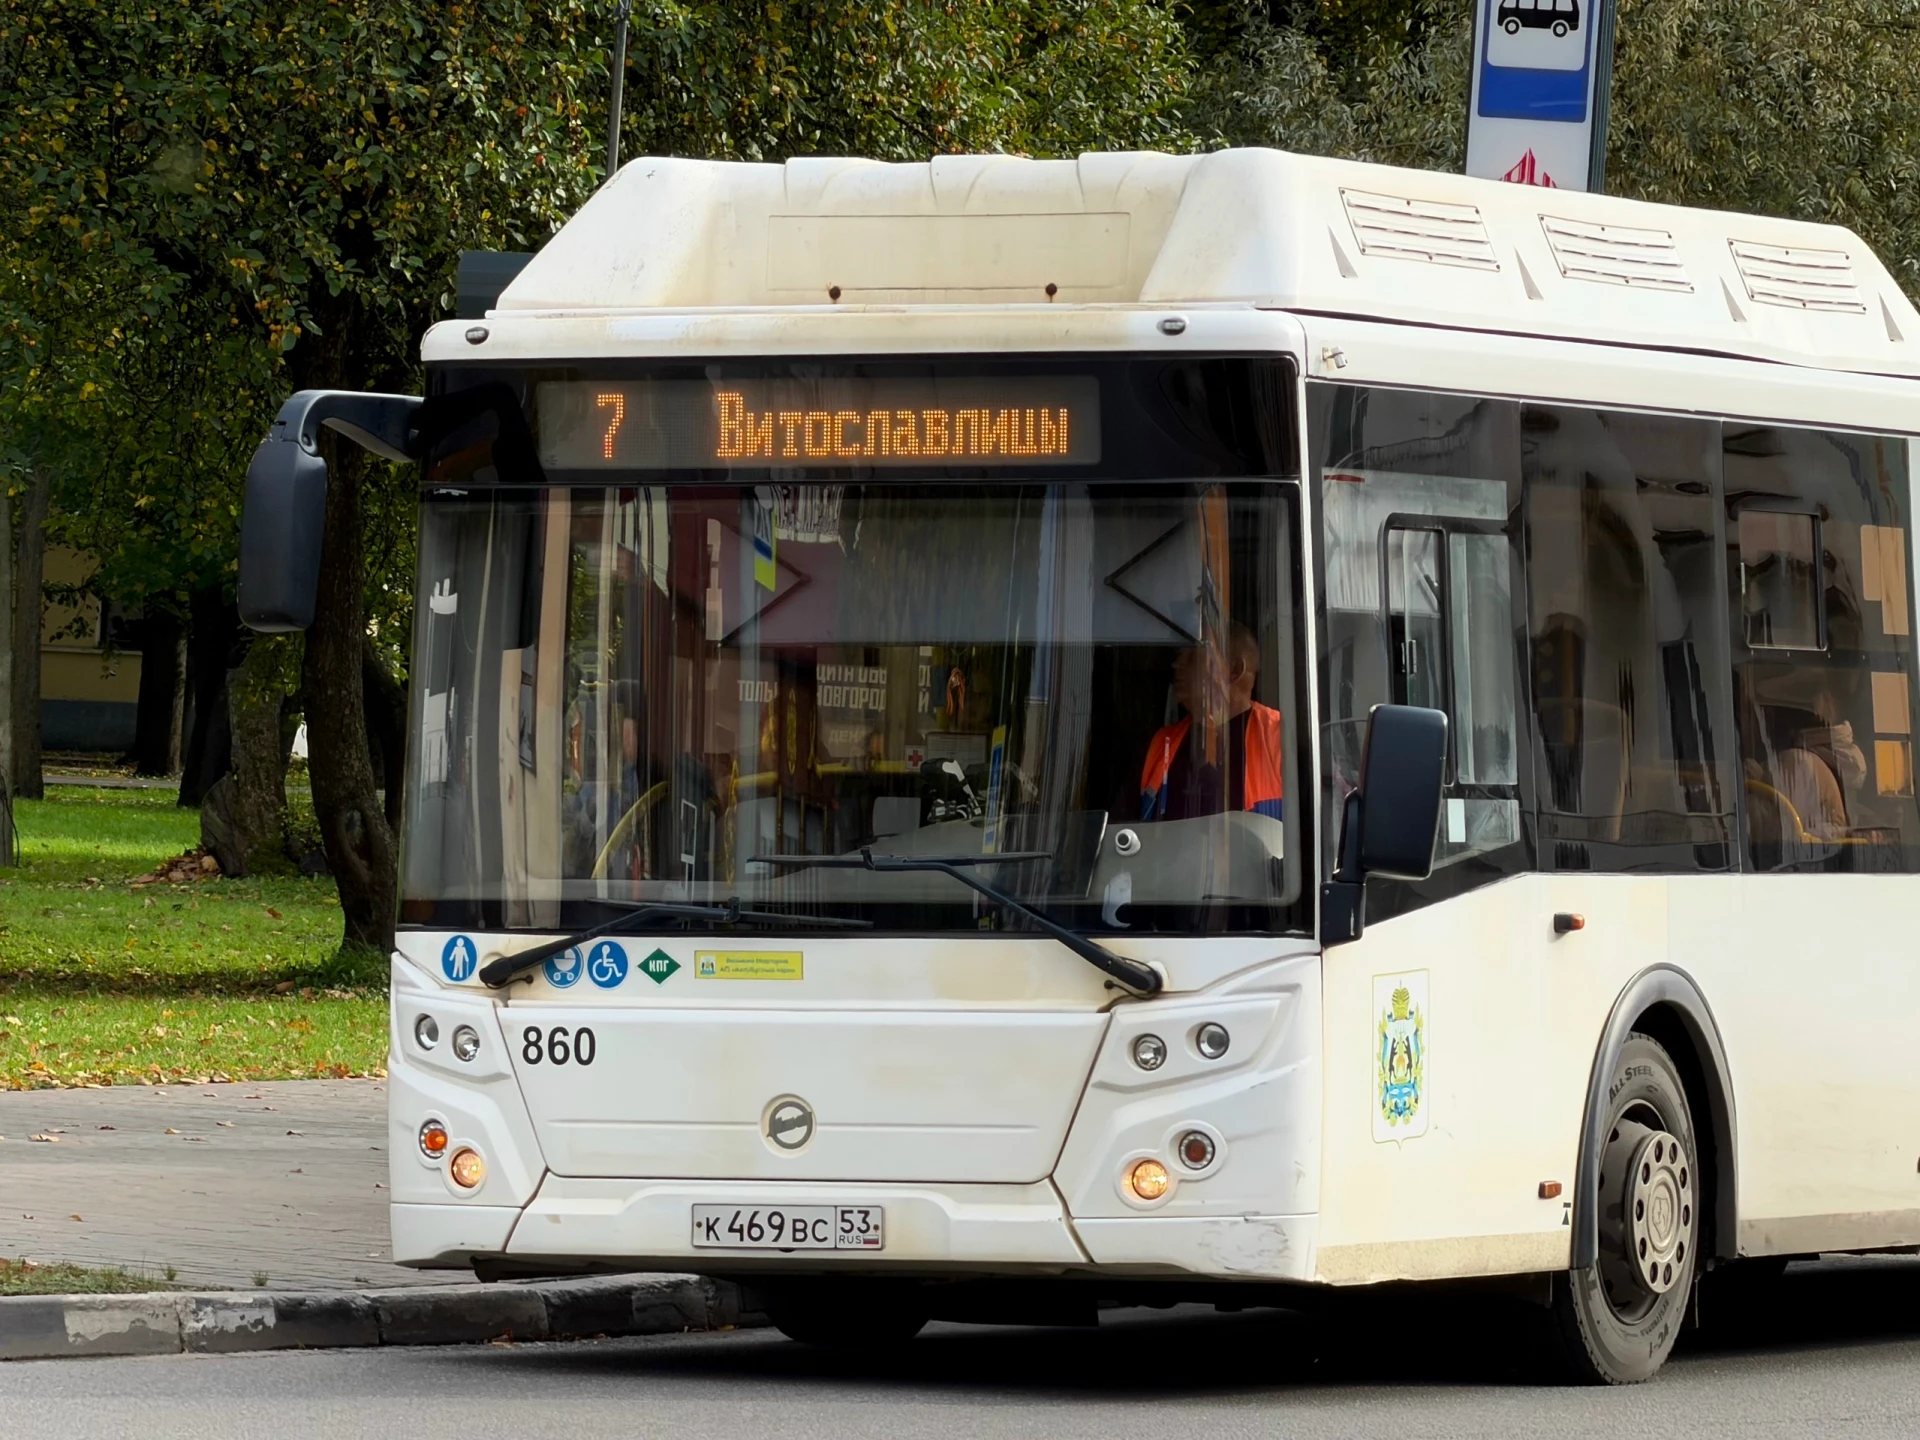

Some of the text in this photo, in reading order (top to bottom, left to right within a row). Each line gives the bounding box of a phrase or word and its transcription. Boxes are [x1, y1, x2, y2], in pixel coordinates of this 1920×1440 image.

[596, 391, 1069, 459] 7 Витославлицы
[648, 959, 670, 973] КПГ
[522, 1025, 596, 1066] 860
[839, 1209, 871, 1235] 53
[838, 1234, 862, 1244] RUS
